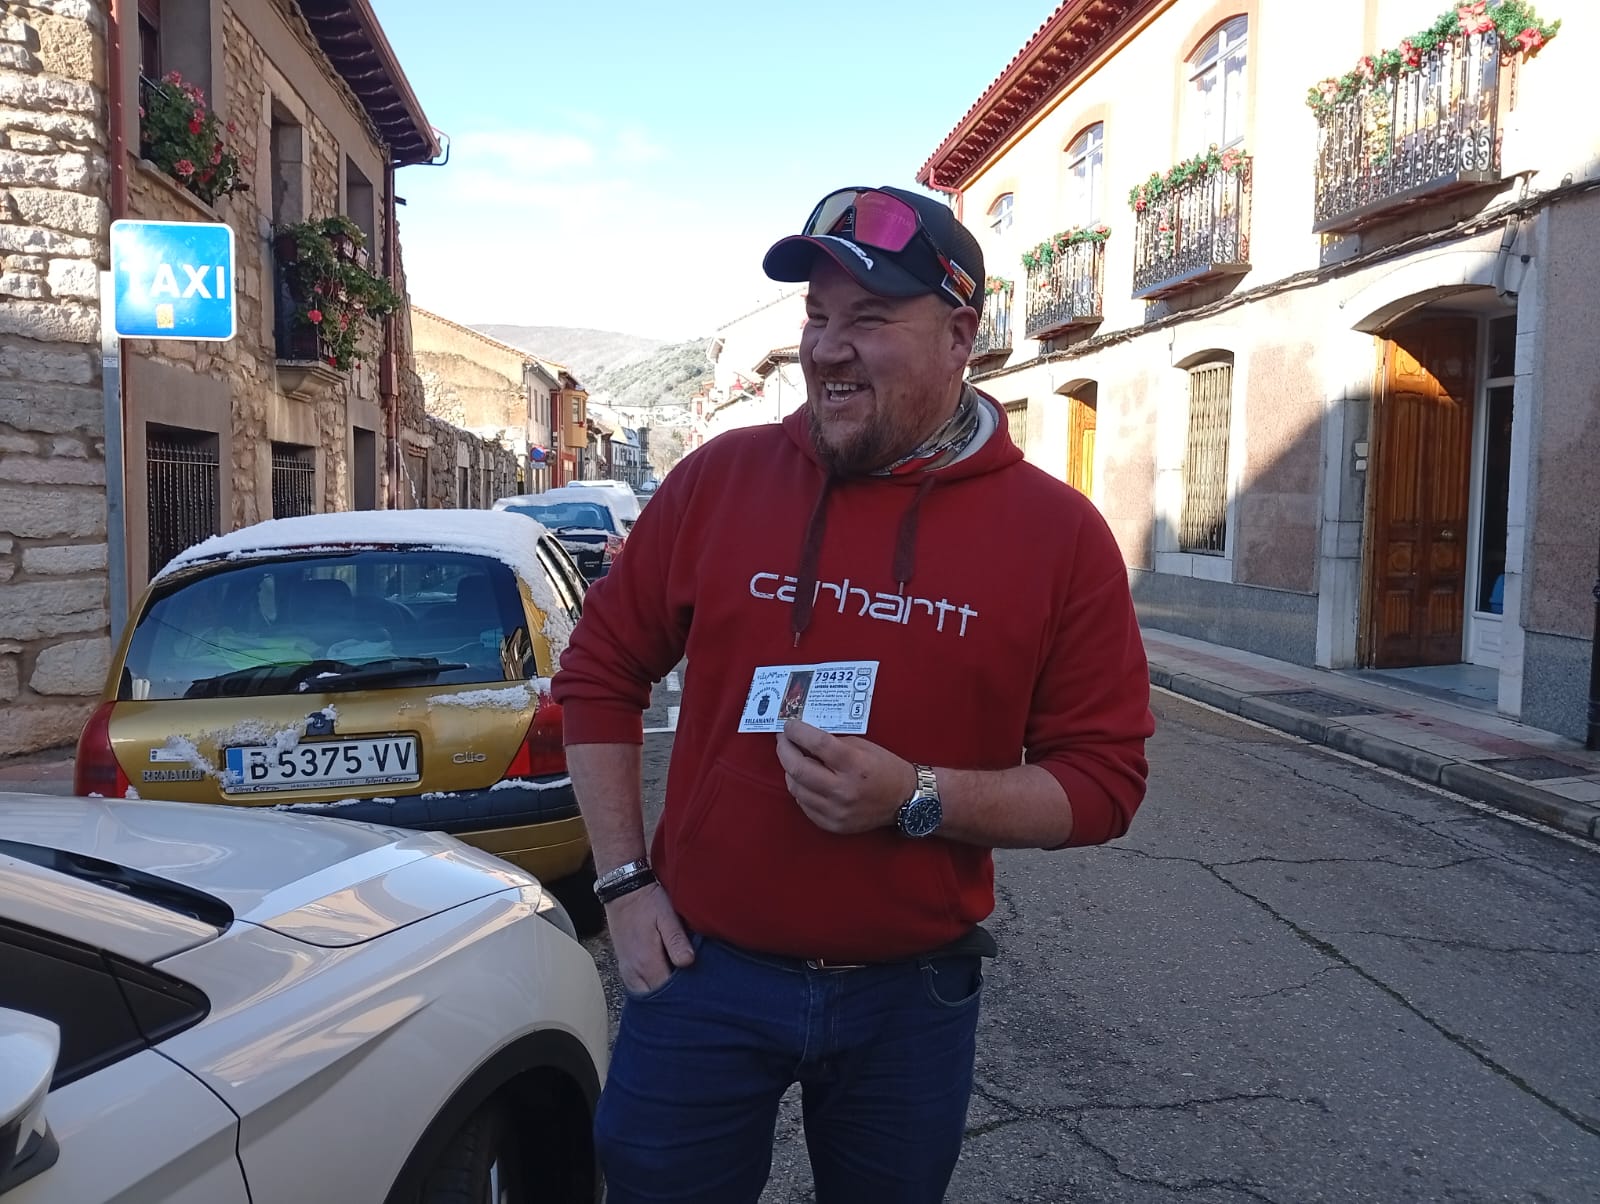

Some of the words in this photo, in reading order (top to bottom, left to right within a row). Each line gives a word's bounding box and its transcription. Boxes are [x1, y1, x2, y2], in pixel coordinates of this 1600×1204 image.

[119, 262, 226, 299] TAXI
[815, 671, 854, 681] 79432
[855, 706, 861, 714] 5
[278, 746, 362, 779] 5375
[372, 742, 412, 772] VV
